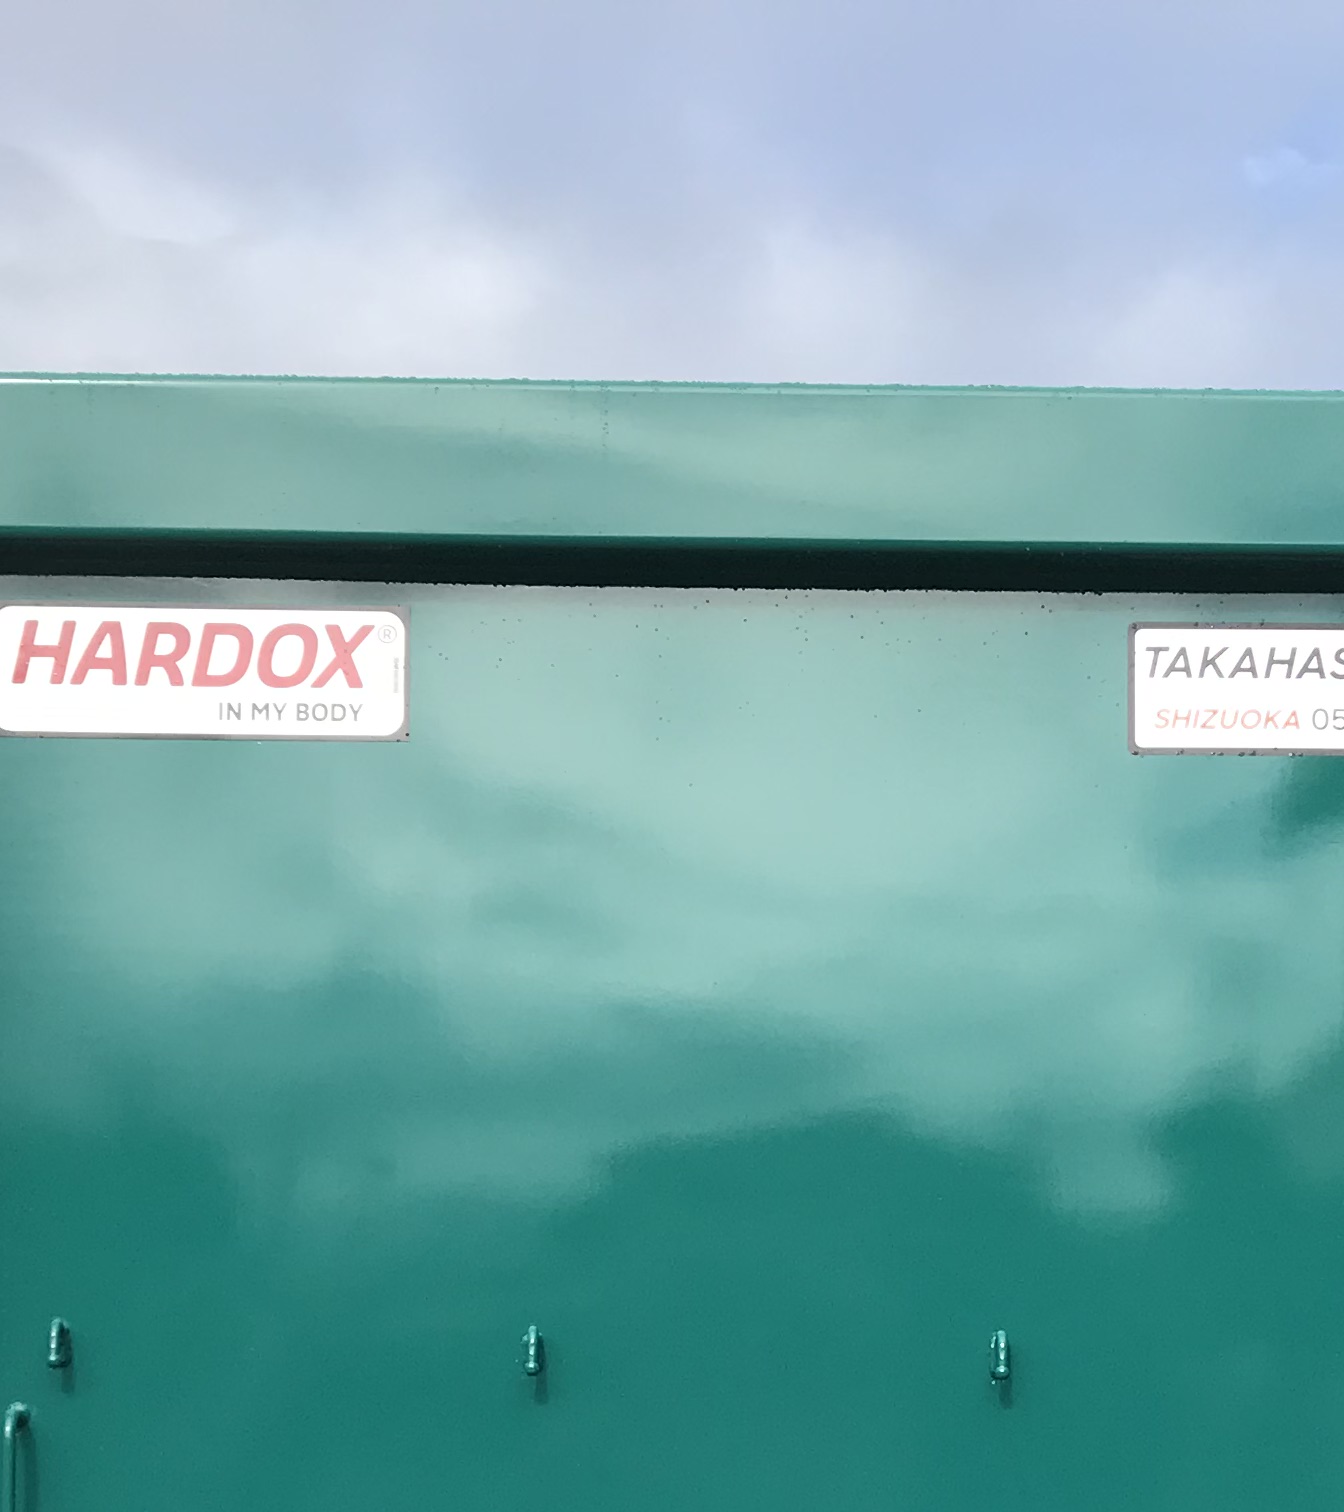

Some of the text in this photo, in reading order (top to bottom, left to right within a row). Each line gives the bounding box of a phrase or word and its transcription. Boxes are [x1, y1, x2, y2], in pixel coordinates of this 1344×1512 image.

[12, 619, 375, 689] HARDOX
[218, 702, 364, 723] IN MY BODY
[1154, 708, 1301, 730] SHIZUOKA
